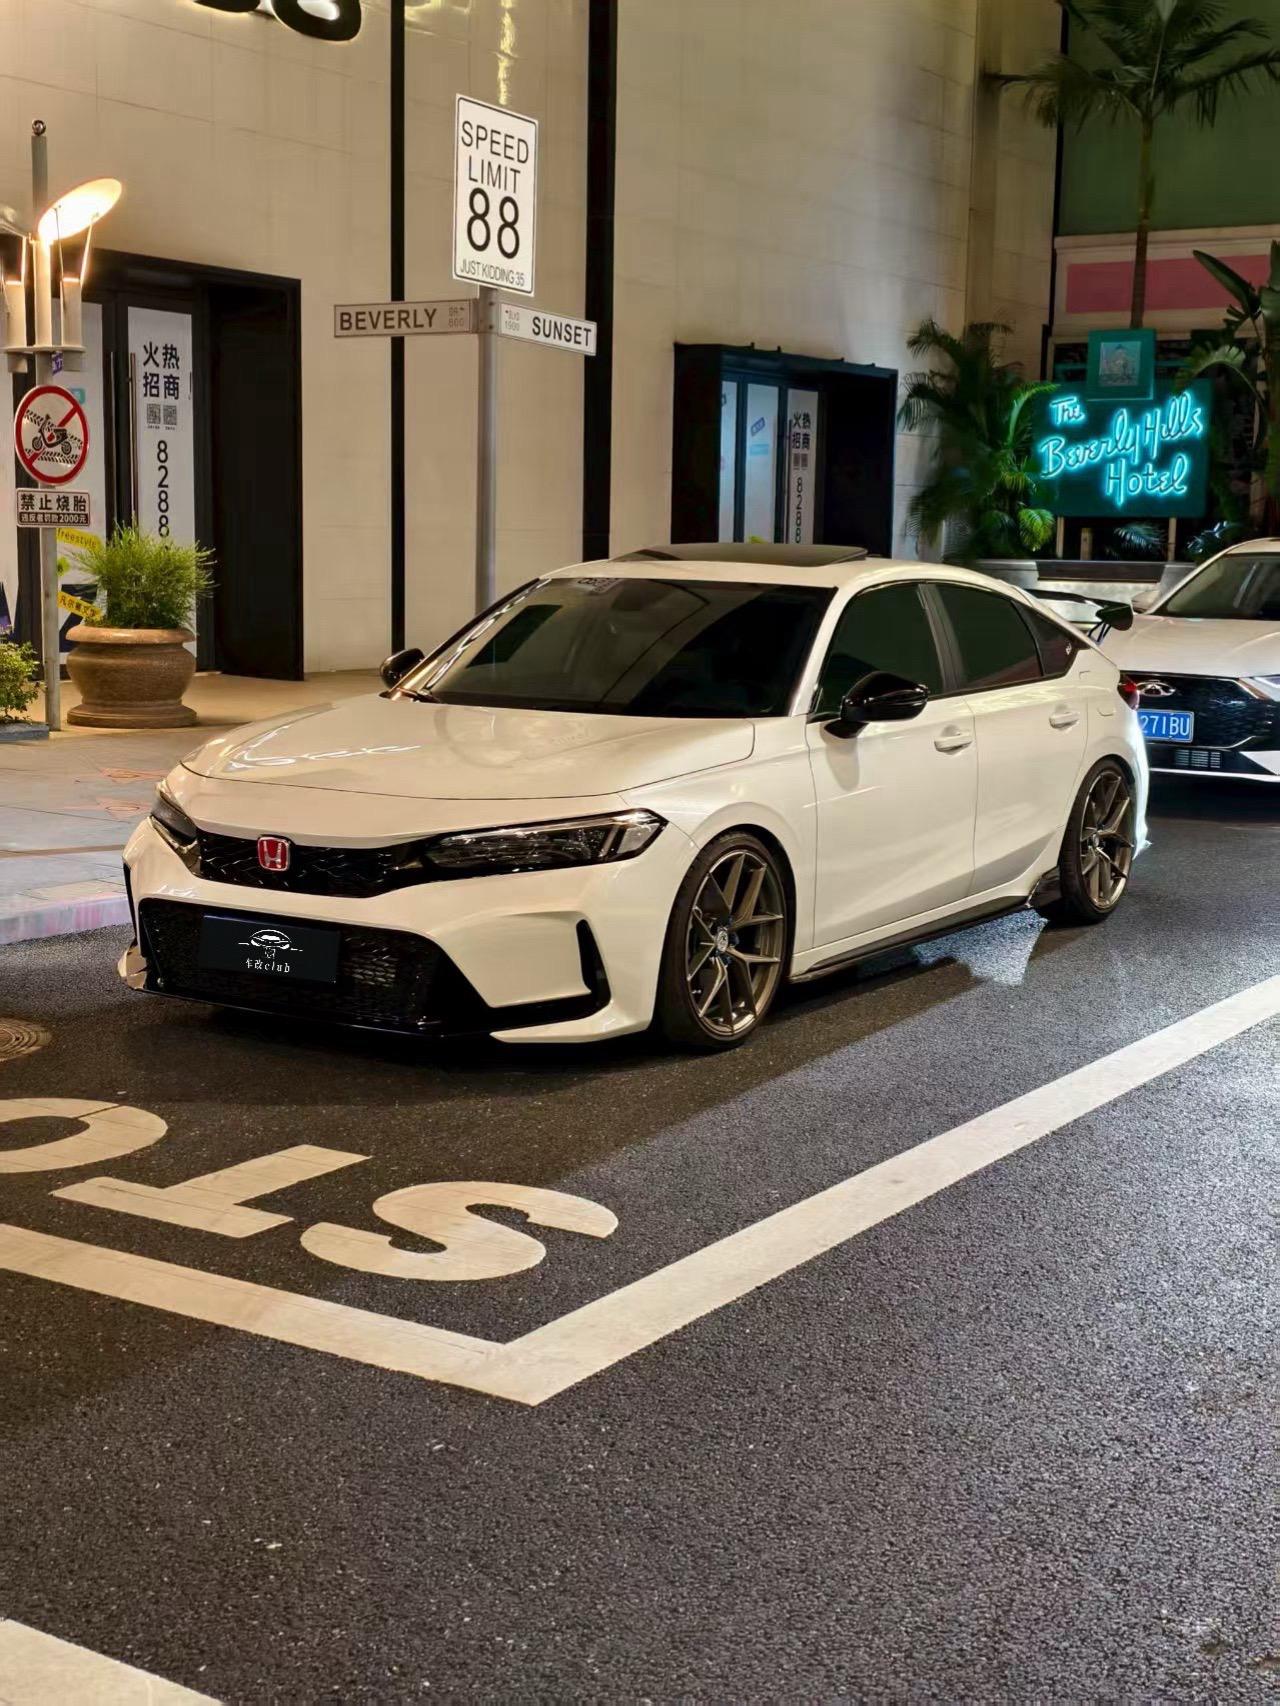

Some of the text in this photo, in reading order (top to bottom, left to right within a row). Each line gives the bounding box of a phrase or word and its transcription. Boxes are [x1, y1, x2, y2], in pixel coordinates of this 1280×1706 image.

[460, 120, 529, 164] SPEED
[468, 155, 521, 194] LIMIT
[466, 187, 520, 260] 88
[460, 258, 525, 287] JUST KIDDING 35
[339, 307, 438, 331] BEVERLY
[531, 315, 592, 347] SUNSET
[142, 341, 180, 370] 火热
[142, 372, 180, 400] 招商
[1048, 396, 1086, 426] The
[1039, 390, 1203, 479] Beverly Hills
[1105, 454, 1188, 506] Hotel
[20, 493, 87, 512] 禁止烧胎
